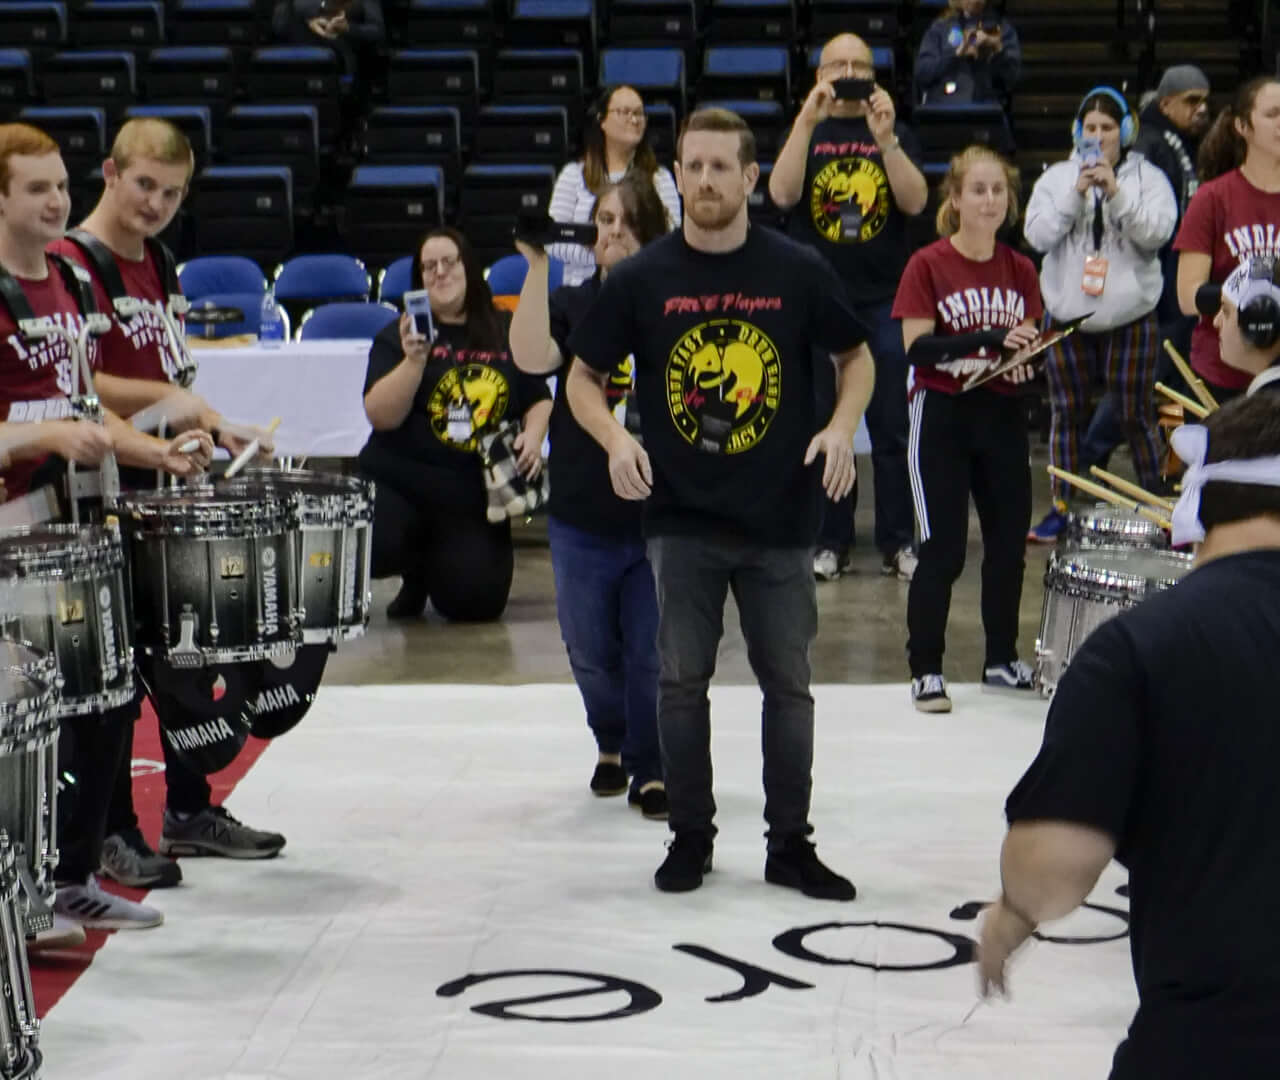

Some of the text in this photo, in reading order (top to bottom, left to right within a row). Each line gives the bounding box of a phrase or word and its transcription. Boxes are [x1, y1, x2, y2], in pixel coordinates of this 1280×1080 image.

[937, 287, 1025, 324] INDIANA
[262, 567, 280, 637] YAMAHA
[173, 717, 235, 751] YAMAHA
